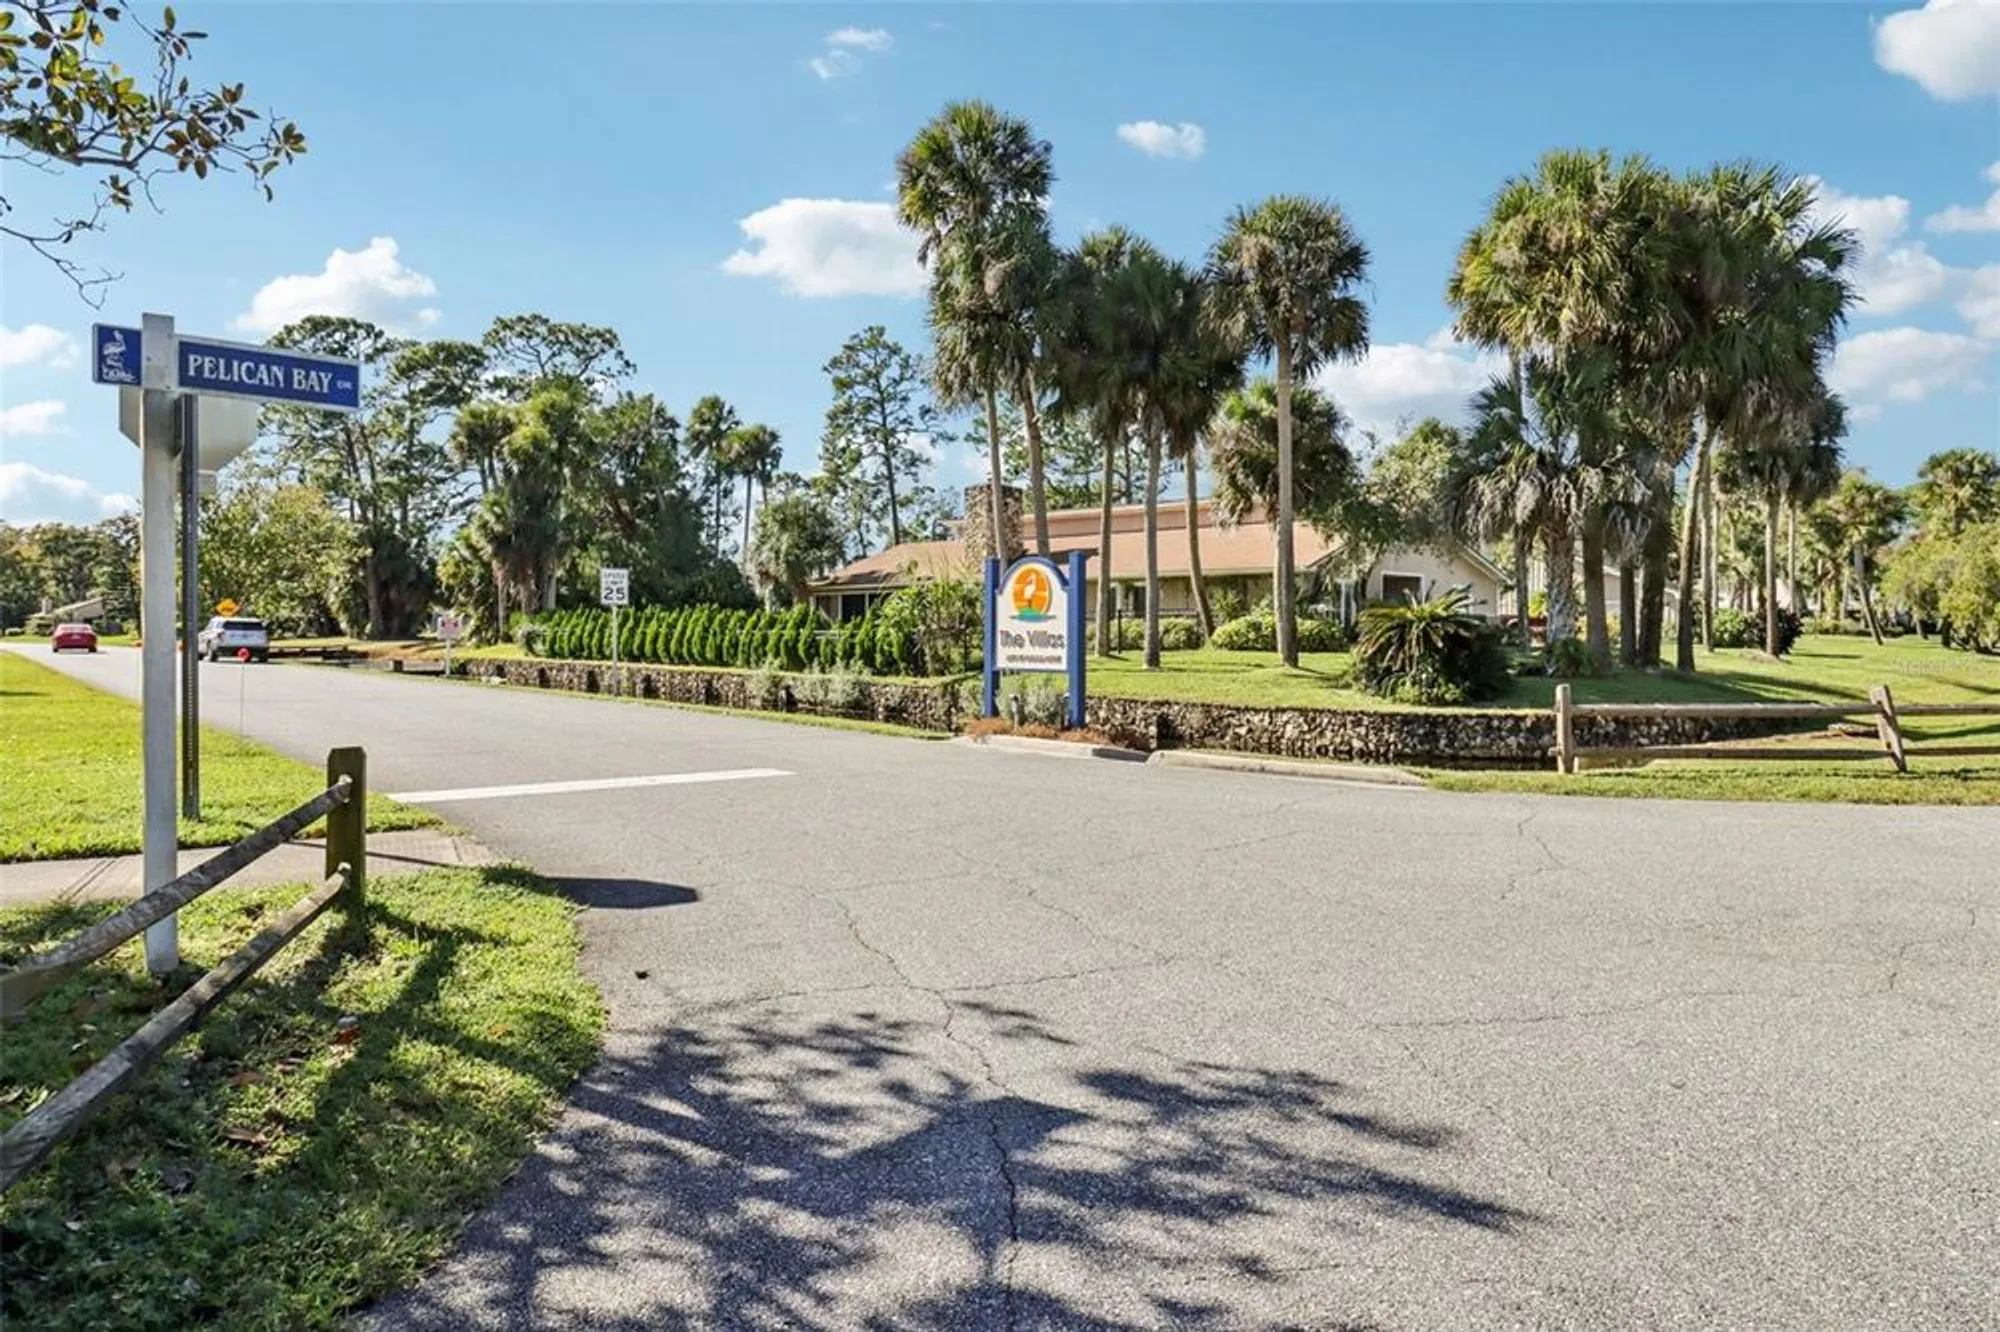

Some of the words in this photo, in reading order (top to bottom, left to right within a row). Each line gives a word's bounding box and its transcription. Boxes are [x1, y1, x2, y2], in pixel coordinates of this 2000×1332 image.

[188, 354, 285, 388] PELICAN
[292, 367, 333, 393] BAY
[604, 586, 625, 601] 25
[1000, 630, 1025, 649] The
[1026, 630, 1066, 649] Villas
